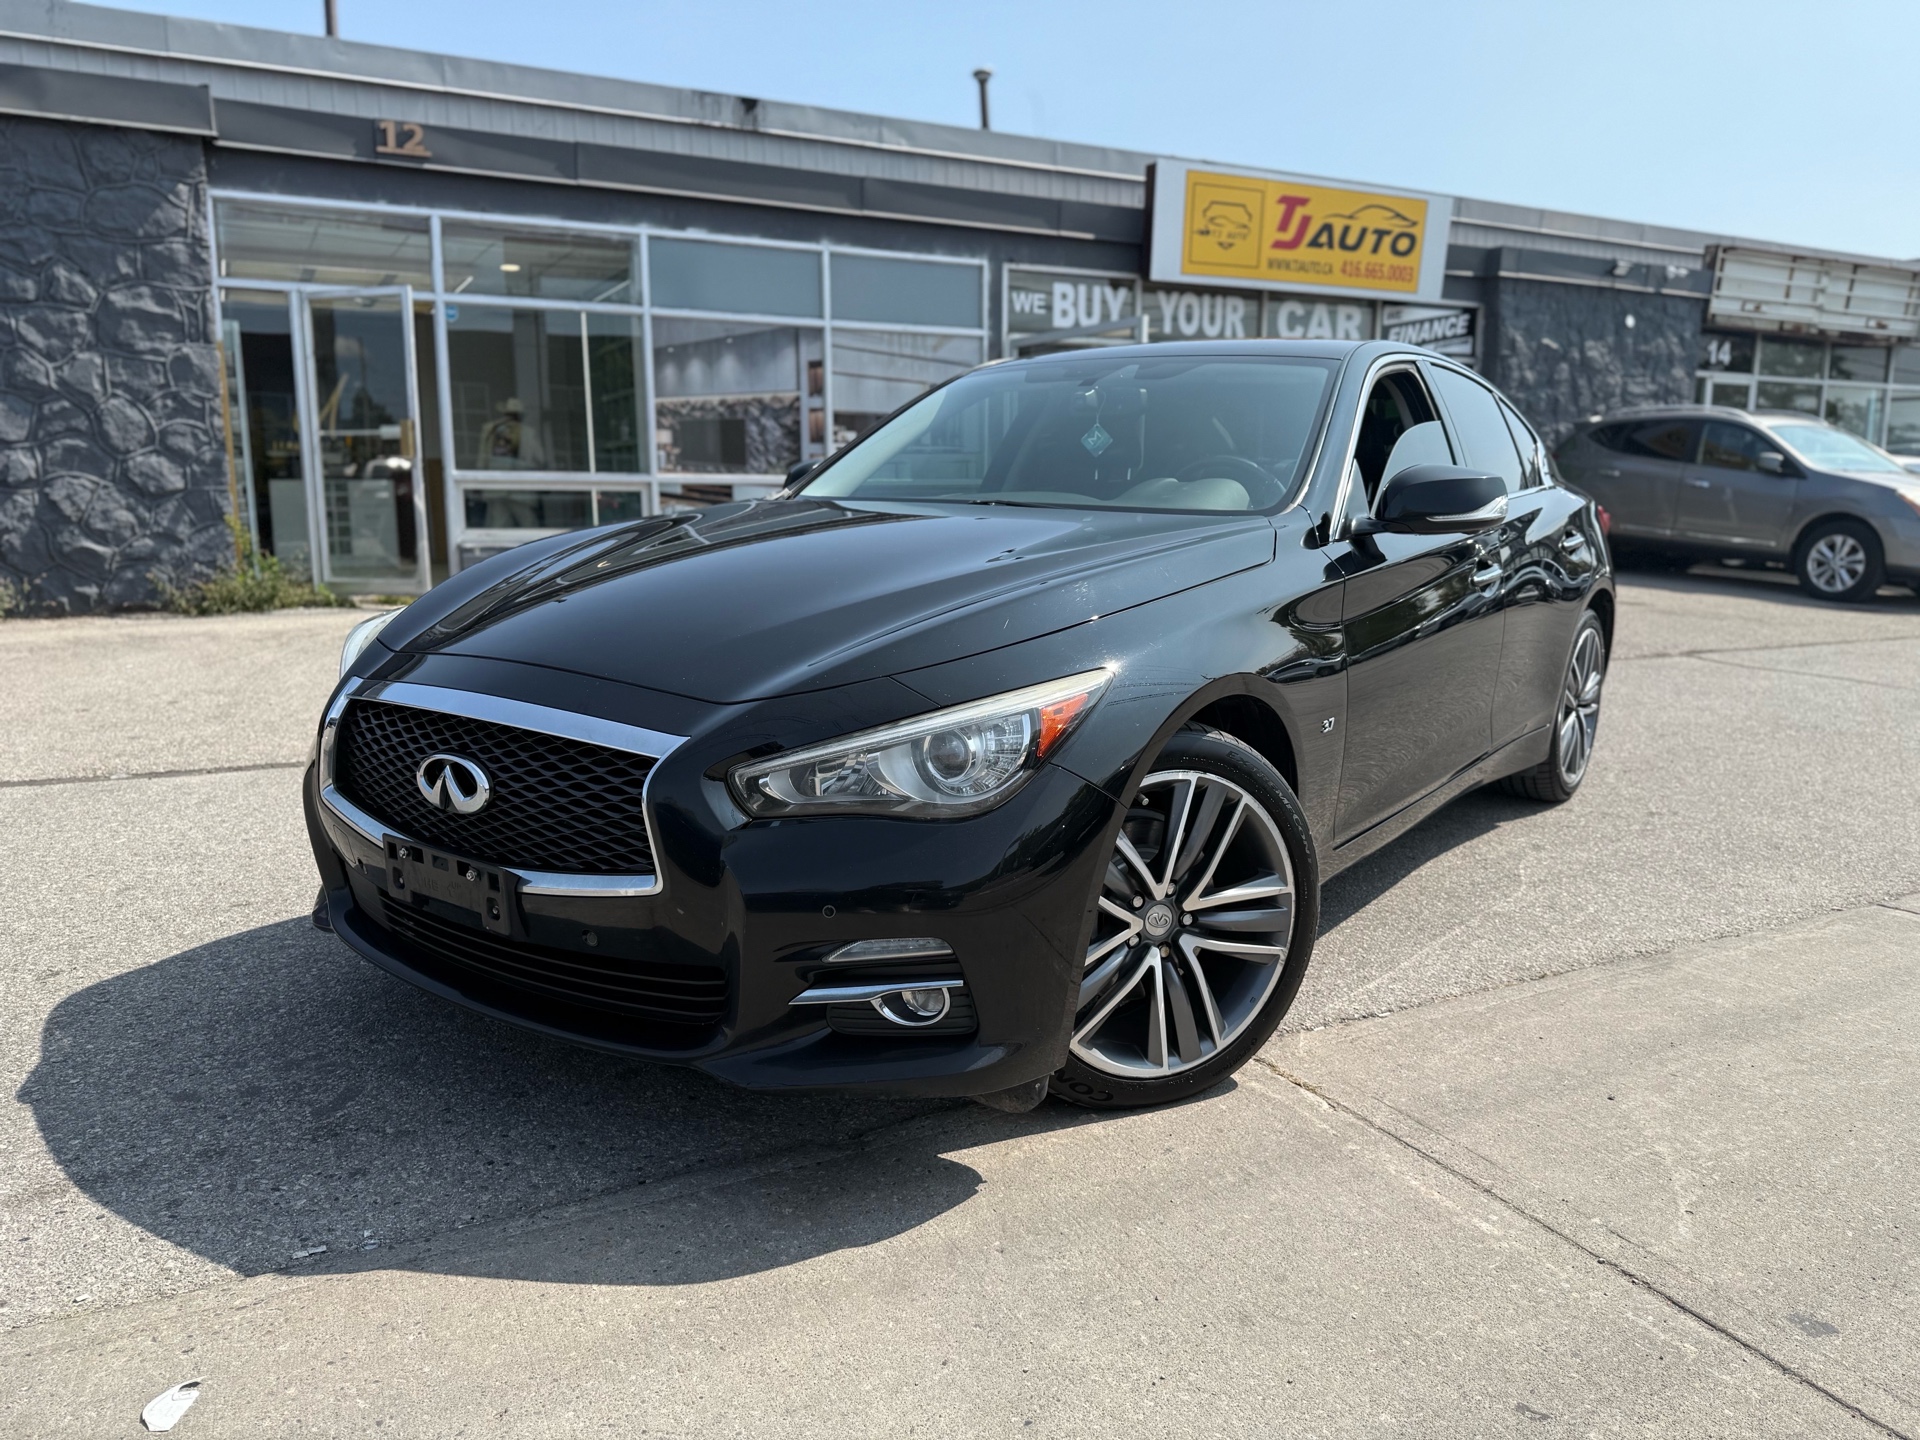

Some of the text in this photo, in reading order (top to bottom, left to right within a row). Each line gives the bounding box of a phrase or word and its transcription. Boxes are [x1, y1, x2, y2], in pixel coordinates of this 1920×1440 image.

[377, 121, 429, 156] 12
[1270, 194, 1416, 257] TJ AUTO
[1011, 282, 1362, 340] WE BUY YOUR CAR
[1387, 313, 1471, 344] FINANCE
[1707, 339, 1732, 366] 14
